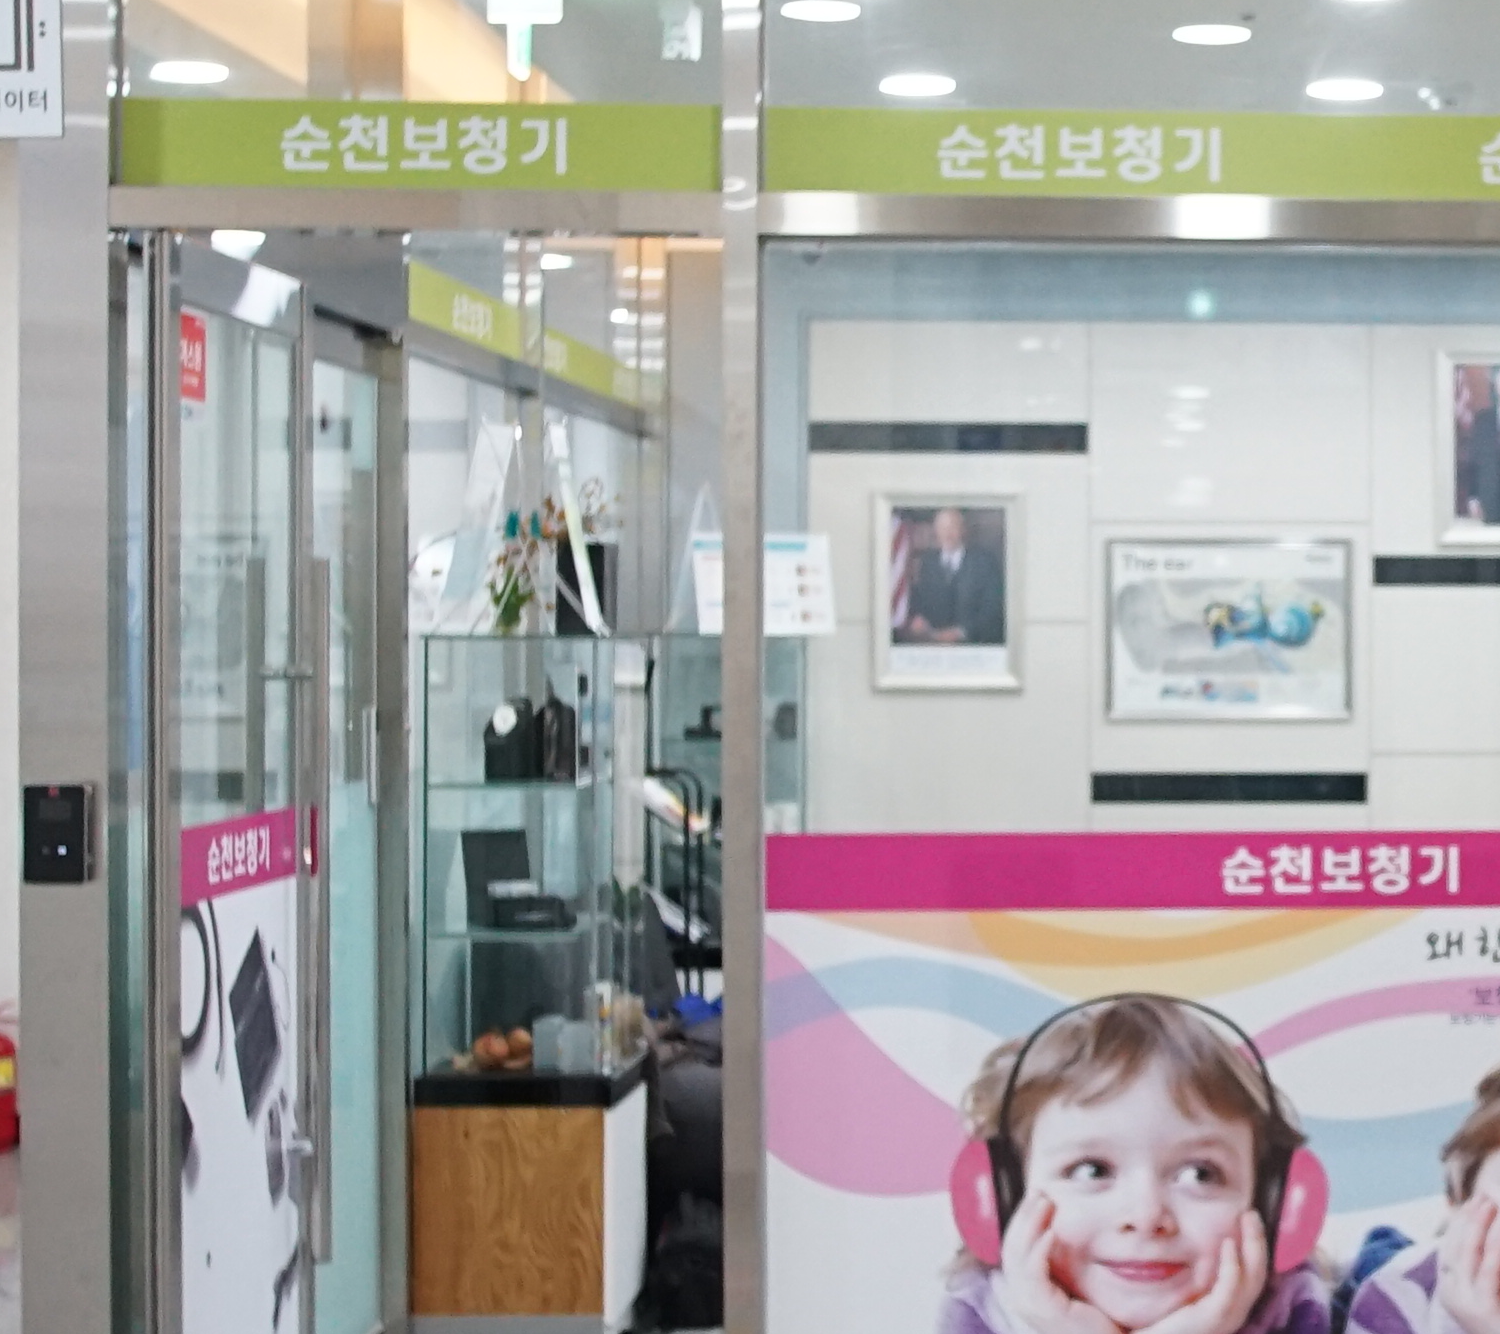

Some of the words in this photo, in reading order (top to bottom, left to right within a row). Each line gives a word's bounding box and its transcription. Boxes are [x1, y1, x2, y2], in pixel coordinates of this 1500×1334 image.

[281, 114, 567, 175] 순천보청기
[937, 124, 1221, 183] 순천보청기
[207, 824, 270, 886] 순천보청기
[1222, 844, 1460, 895] 순천보청기
[1426, 930, 1463, 961] 왜
